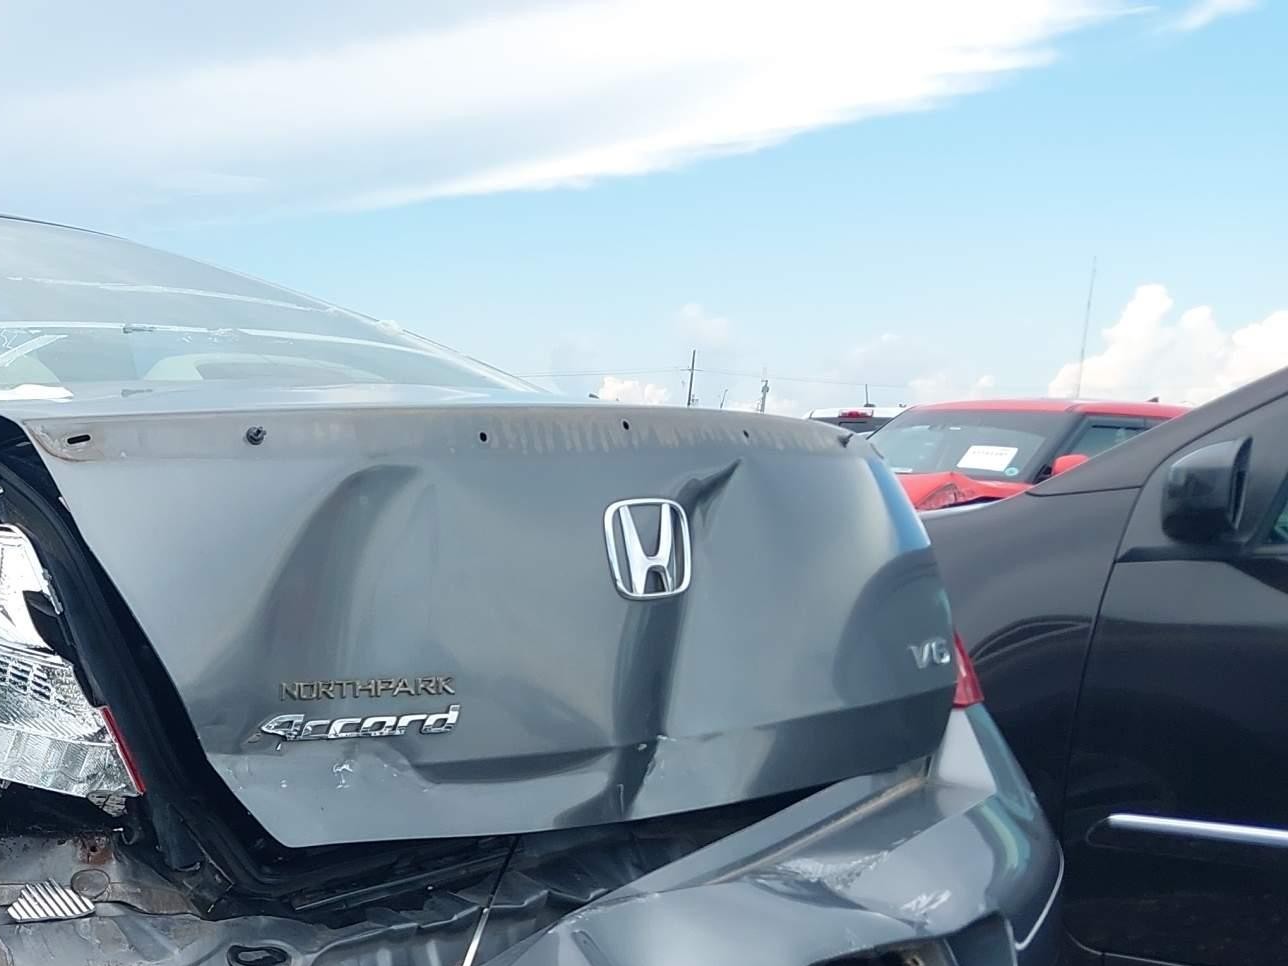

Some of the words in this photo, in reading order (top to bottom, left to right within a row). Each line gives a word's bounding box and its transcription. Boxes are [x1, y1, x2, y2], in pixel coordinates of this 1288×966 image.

[908, 638, 951, 669] V6
[279, 676, 455, 700] NORTHPARK
[261, 704, 460, 741] Accord
